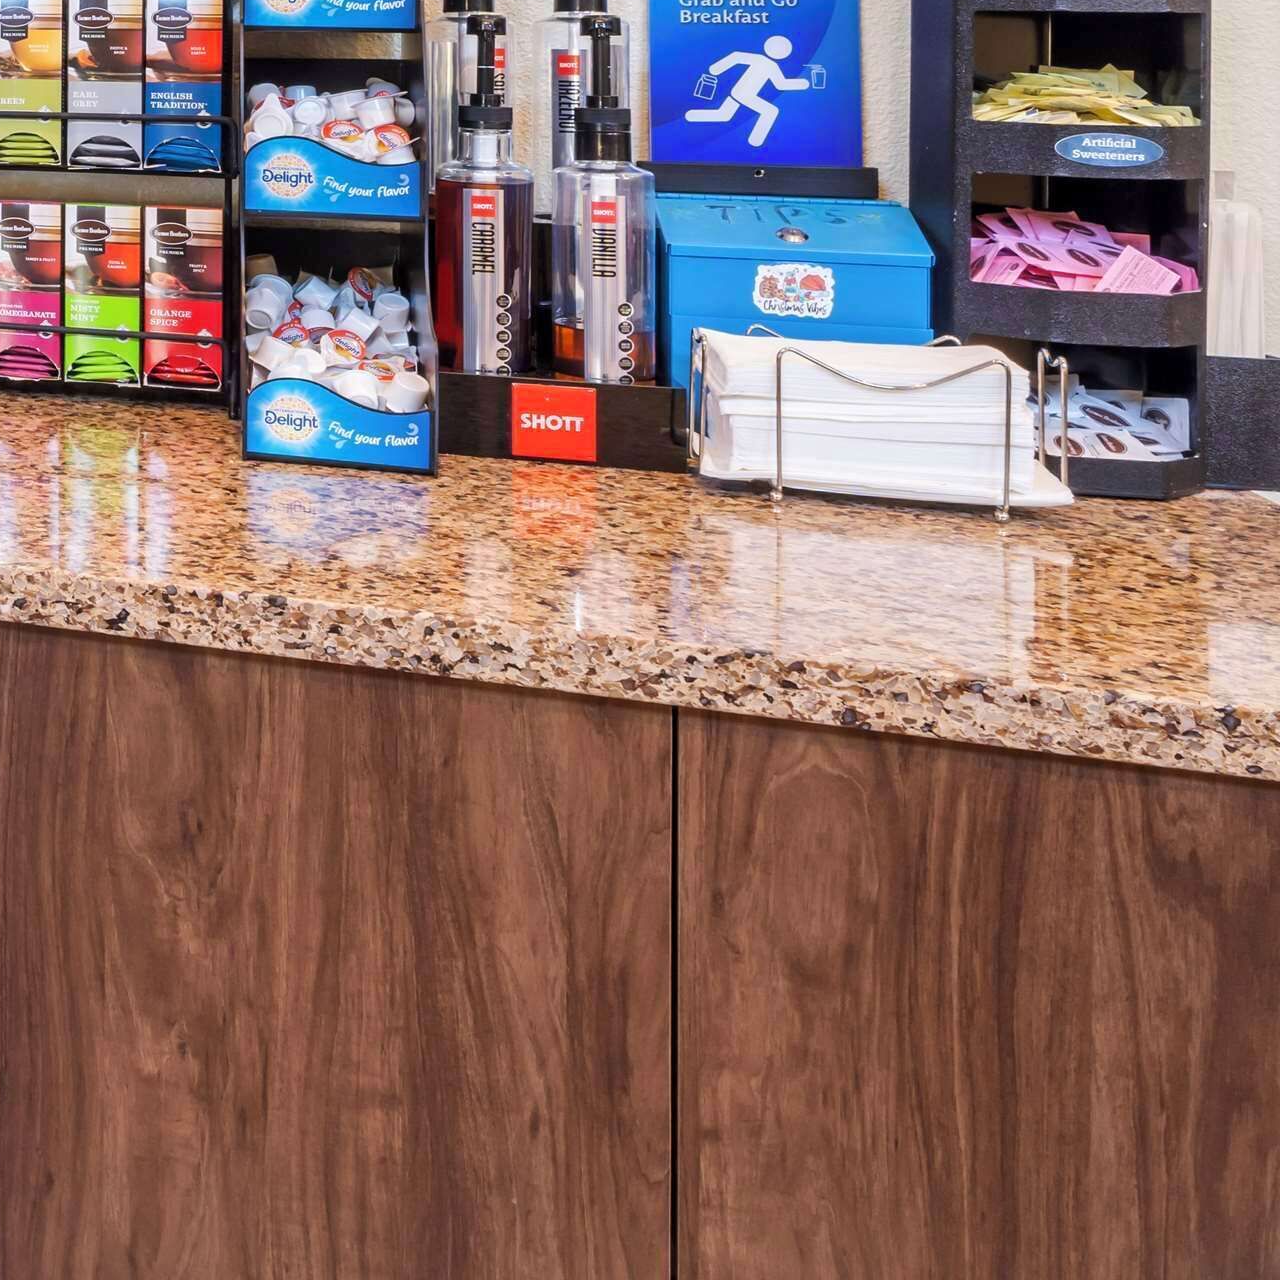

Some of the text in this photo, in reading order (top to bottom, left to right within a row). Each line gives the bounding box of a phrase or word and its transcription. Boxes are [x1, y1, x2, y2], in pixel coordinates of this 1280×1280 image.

[345, 1, 370, 11] your
[679, 9, 769, 24] Breakfast
[73, 100, 98, 108] GREY
[151, 92, 193, 100] ENGLISH
[1081, 137, 1136, 149] Artificial
[1072, 149, 1145, 161] Sweeteners
[262, 169, 314, 187] Delight
[322, 176, 348, 192] Find
[349, 185, 374, 197] your
[471, 222, 496, 276] CARAMEL
[592, 228, 617, 278] VANILLA
[70, 305, 100, 313] MISTY
[150, 309, 192, 318] ORANGE
[763, 299, 828, 316] Christmas Vibes
[149, 318, 179, 327] SPICE
[334, 337, 360, 357] delight
[264, 410, 319, 431] Delight
[520, 413, 585, 432] SHOTT
[328, 421, 354, 439] Find
[354, 433, 382, 445] your
